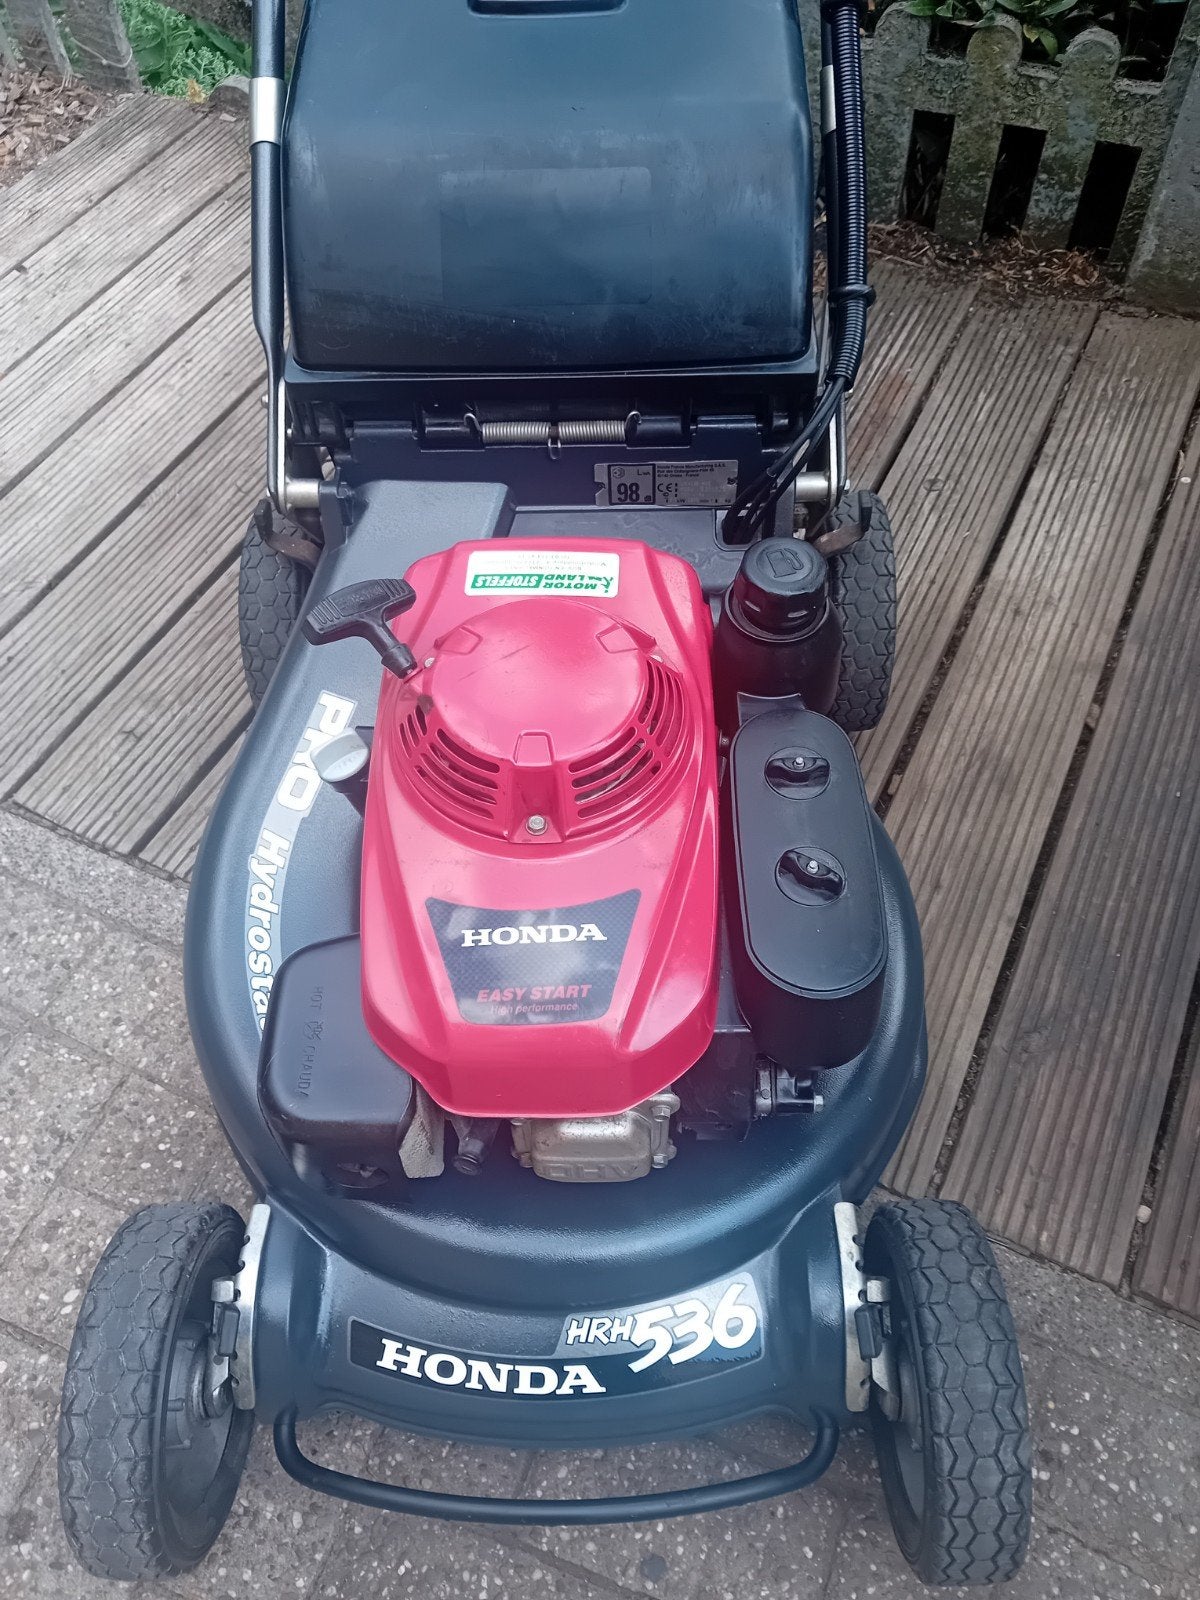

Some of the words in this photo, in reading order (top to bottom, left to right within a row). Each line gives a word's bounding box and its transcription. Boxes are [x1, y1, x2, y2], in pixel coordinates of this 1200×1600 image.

[617, 482, 640, 502] 98
[475, 575, 539, 587] STOFFELS
[543, 582, 597, 590] MOTOR
[248, 828, 292, 1032] Hydrosta
[461, 923, 608, 947] HONDA
[477, 987, 527, 1003] EASY
[530, 984, 592, 1000] START
[491, 1004, 513, 1016] High
[515, 1002, 578, 1015] performance
[565, 1317, 632, 1347] HRH
[628, 1284, 758, 1373] 536
[376, 1338, 607, 1396] HONDA
